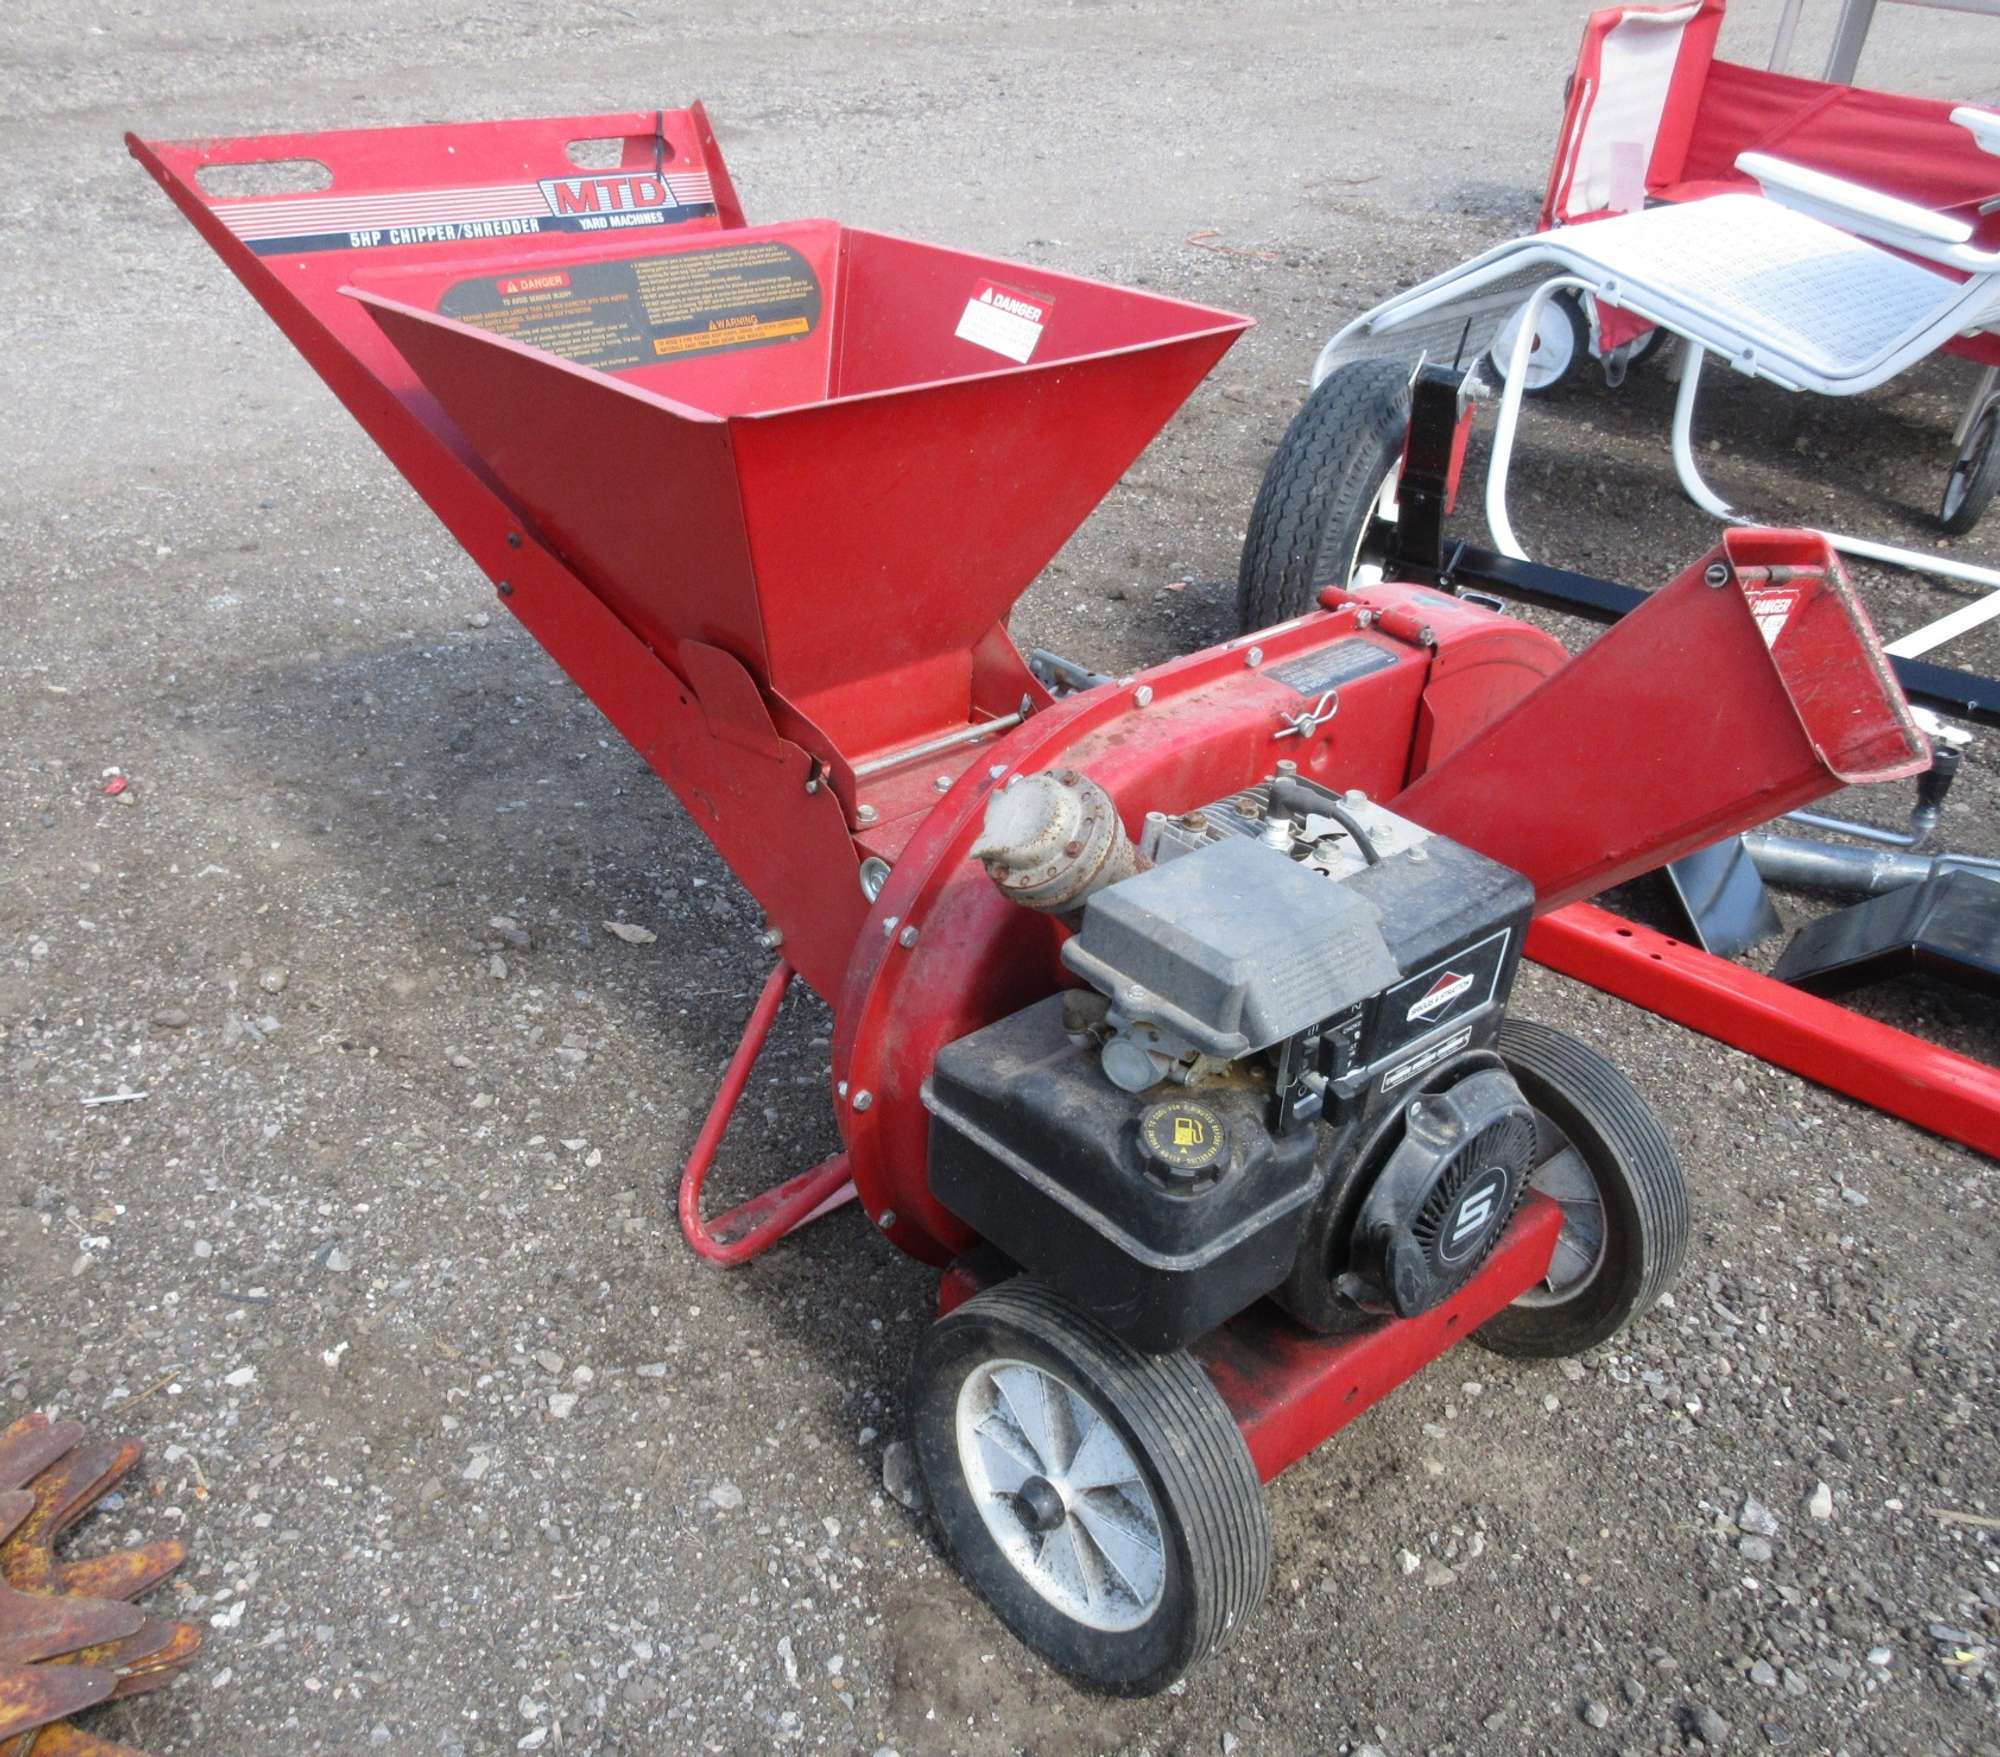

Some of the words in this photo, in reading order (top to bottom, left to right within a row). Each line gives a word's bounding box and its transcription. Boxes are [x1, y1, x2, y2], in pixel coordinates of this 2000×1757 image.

[553, 176, 667, 214] MTD
[578, 217, 608, 230] YARD
[608, 211, 665, 228] MACHINES
[350, 231, 382, 248] 5HP
[390, 218, 540, 245] CHIPPER/SHREDDER
[520, 275, 563, 291] DANGER
[992, 293, 1043, 322] DANGER
[716, 314, 759, 330] WARNING
